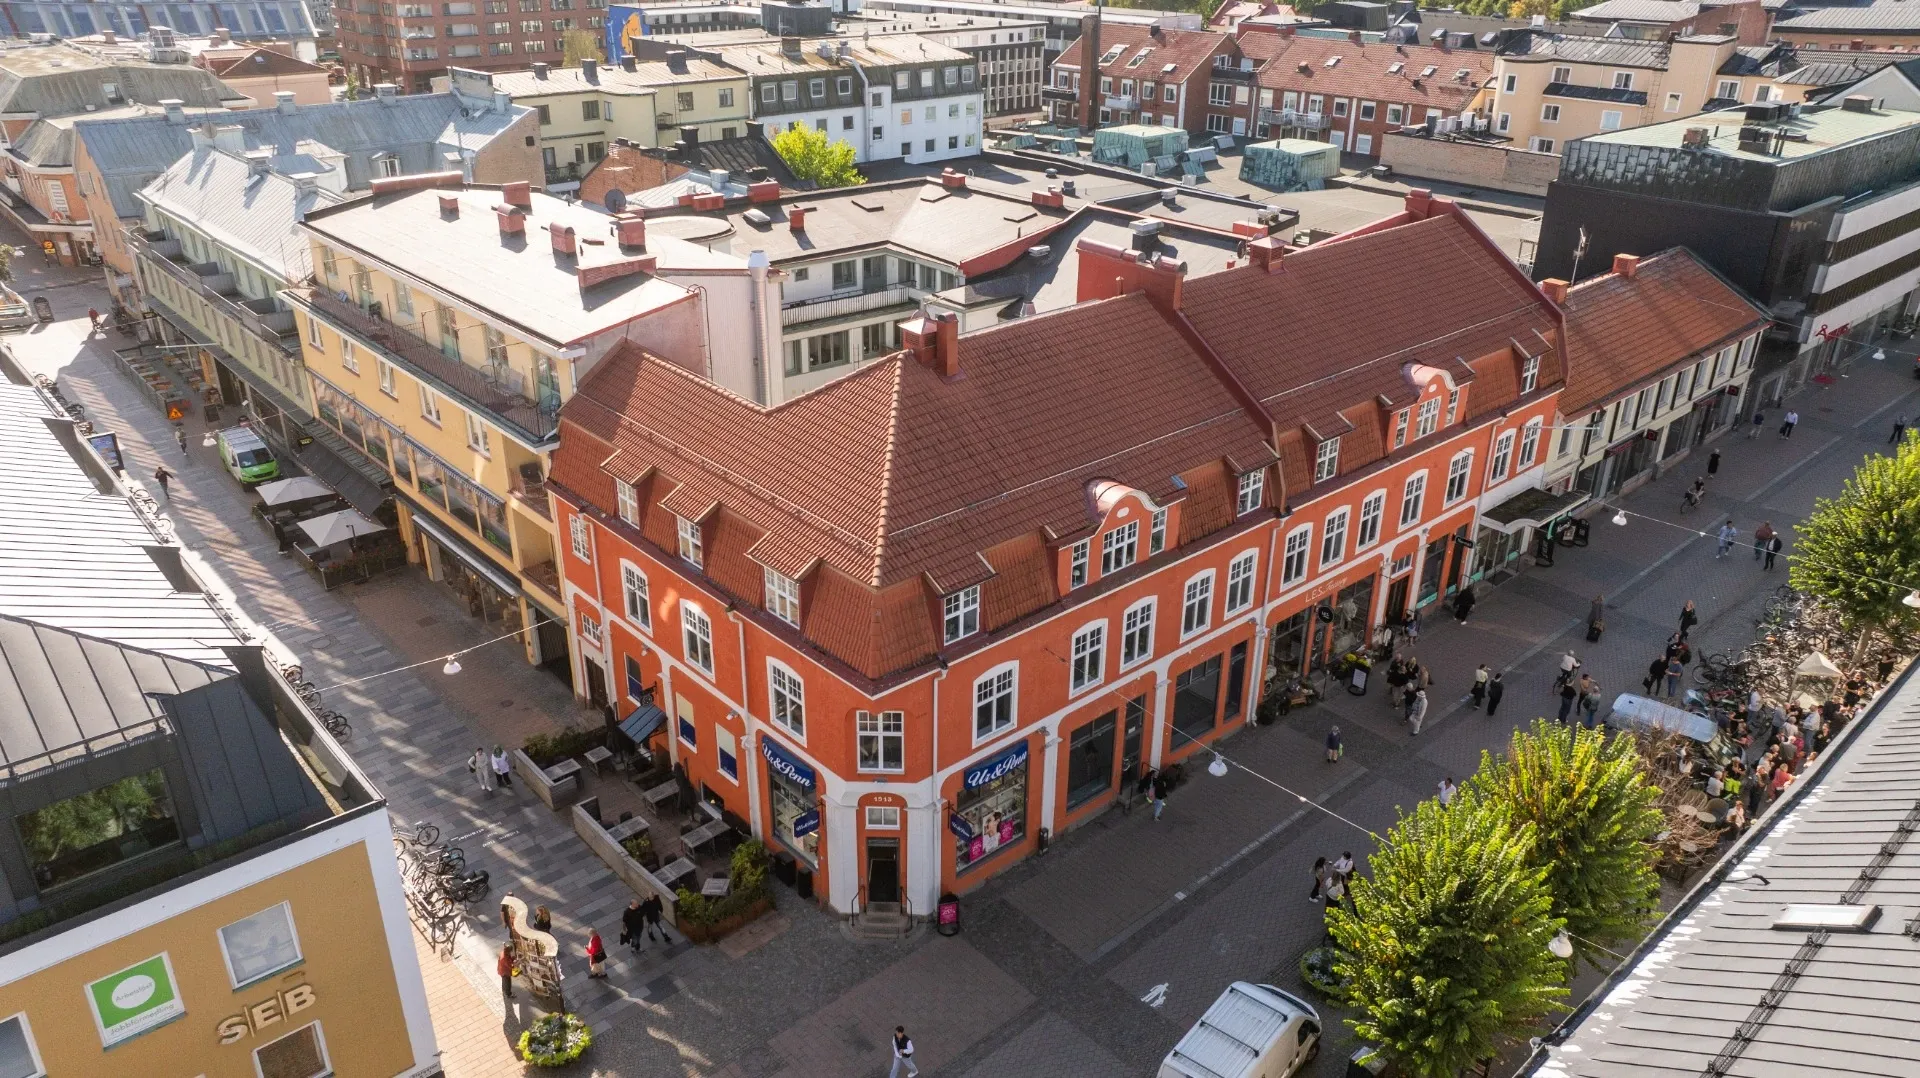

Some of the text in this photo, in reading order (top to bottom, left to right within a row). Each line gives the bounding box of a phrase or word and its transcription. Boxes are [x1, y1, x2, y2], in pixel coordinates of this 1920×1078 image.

[762, 743, 811, 787] Ur&Penn
[968, 751, 1028, 787] Ur&Penn
[217, 984, 316, 1045] SEB
